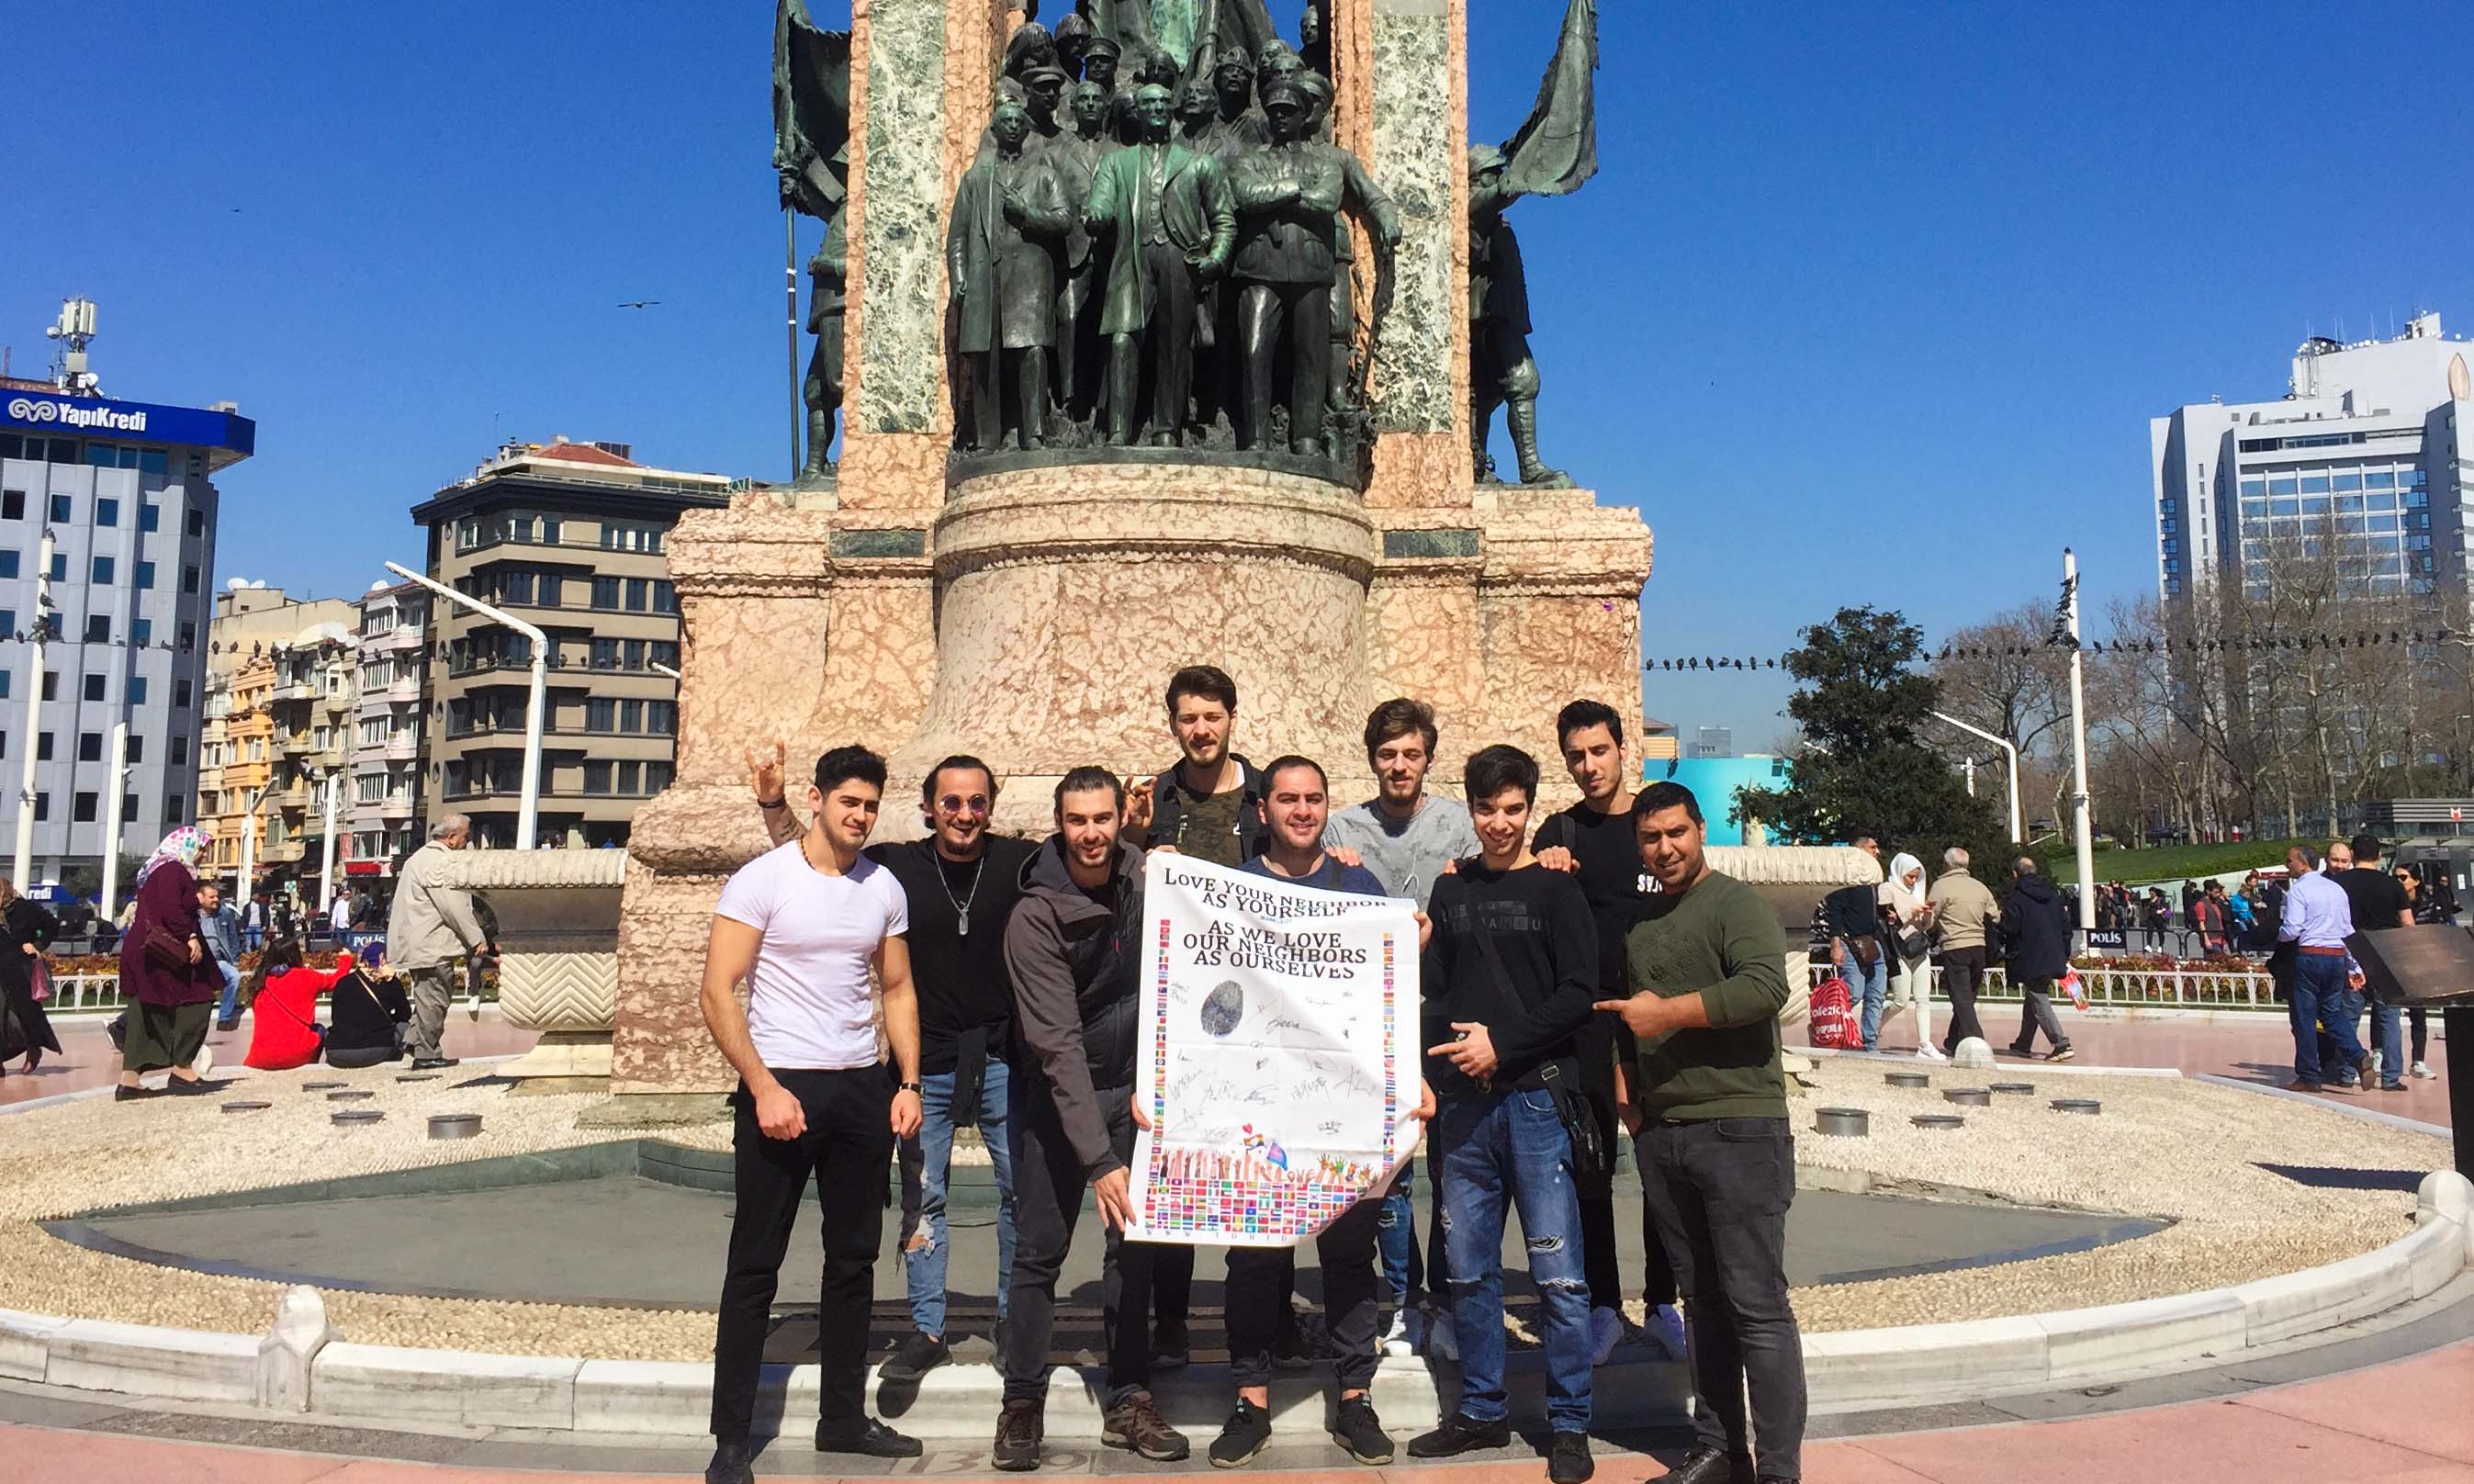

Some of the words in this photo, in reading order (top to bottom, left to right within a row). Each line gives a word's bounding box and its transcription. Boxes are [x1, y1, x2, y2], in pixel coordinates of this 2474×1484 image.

[1164, 868, 1216, 892] LOVE
[1223, 880, 1274, 904] YOUR
[1280, 895, 1388, 908] NEIGHBOR
[1202, 892, 1228, 908] AS
[1236, 895, 1348, 919] YOURSELF
[1208, 919, 1235, 936] AS
[1241, 927, 1276, 945] WE
[1284, 932, 1342, 948] LOVE
[1183, 933, 1230, 951] OUR
[1238, 938, 1366, 964] NEIGHBORS
[1193, 950, 1221, 966] AS
[1230, 951, 1355, 979] OURSELVES
